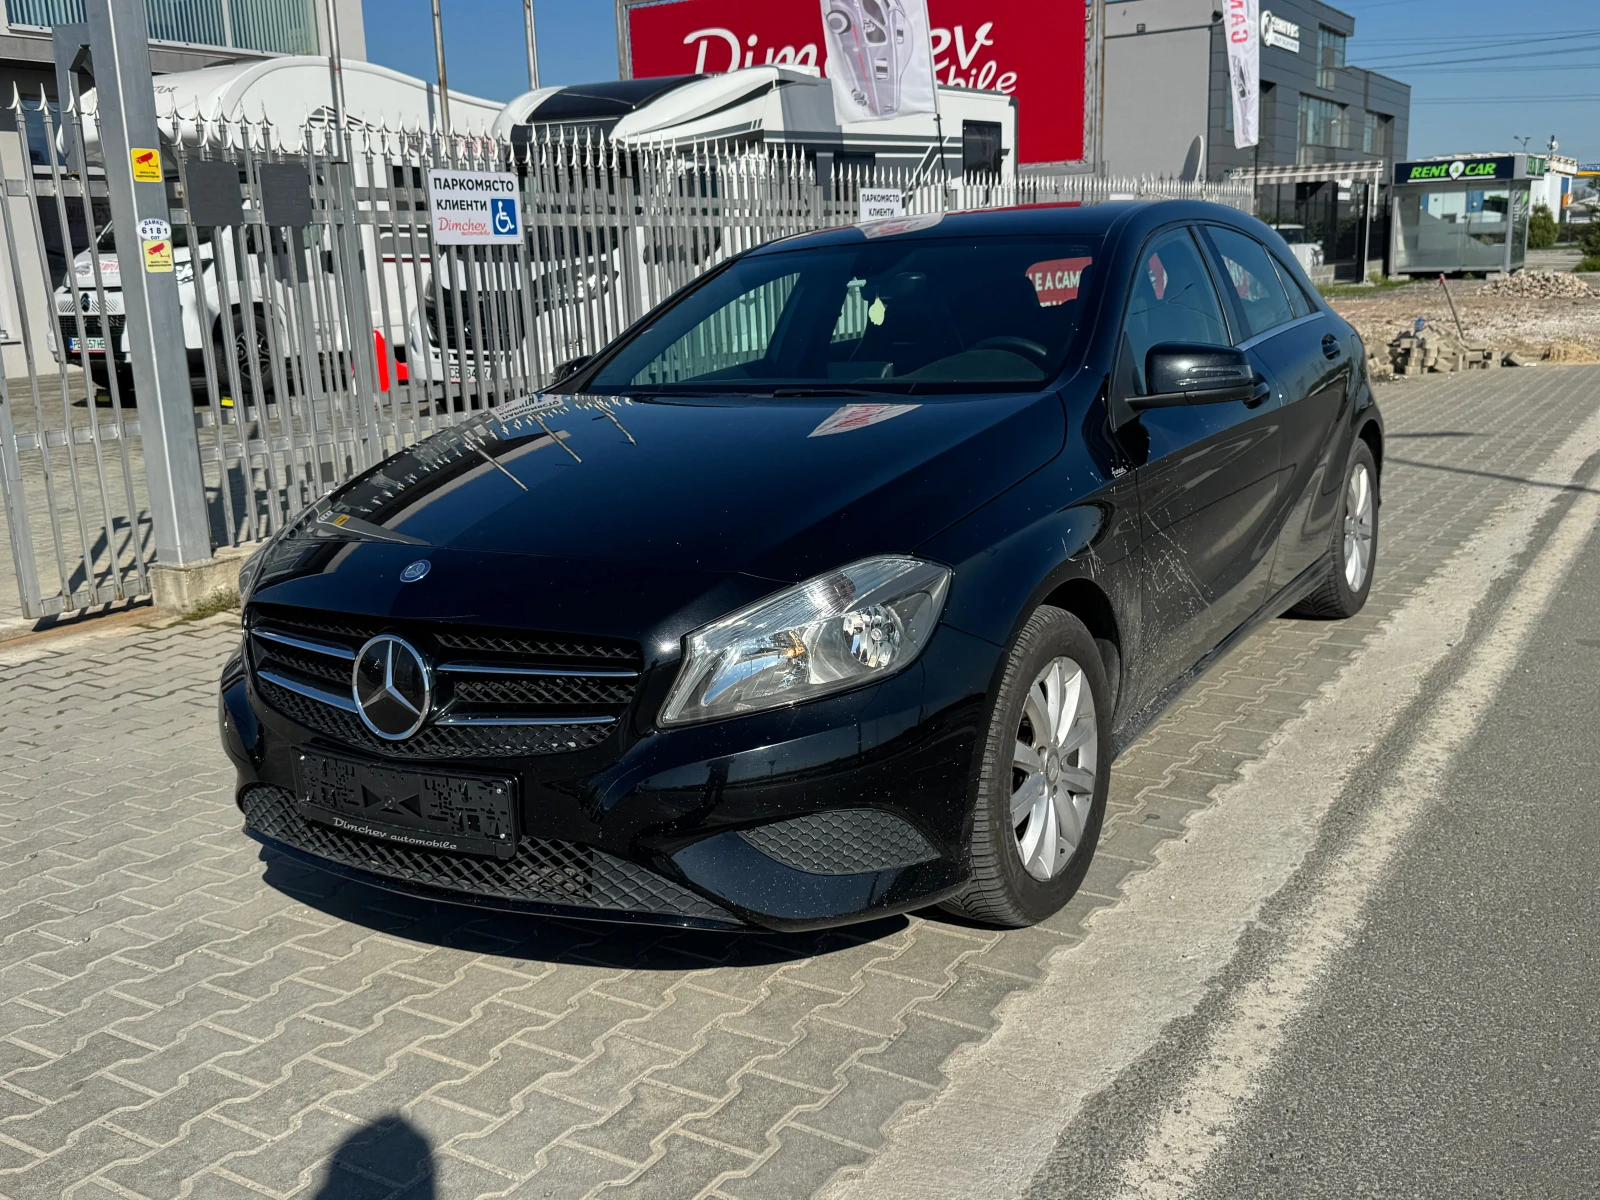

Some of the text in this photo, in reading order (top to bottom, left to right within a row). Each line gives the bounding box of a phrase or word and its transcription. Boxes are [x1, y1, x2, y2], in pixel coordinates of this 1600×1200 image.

[1465, 163, 1497, 175] CAR
[433, 178, 514, 192] ПАРКОМЯСТО
[436, 199, 487, 211] КЛИЕНТИ
[861, 194, 900, 203] ПАРКОМЯСТО
[869, 208, 895, 217] КЛИЕНТИ
[438, 217, 486, 231] Dimchev
[1044, 272, 1054, 290] A
[333, 817, 457, 850] Dimchev automobile
